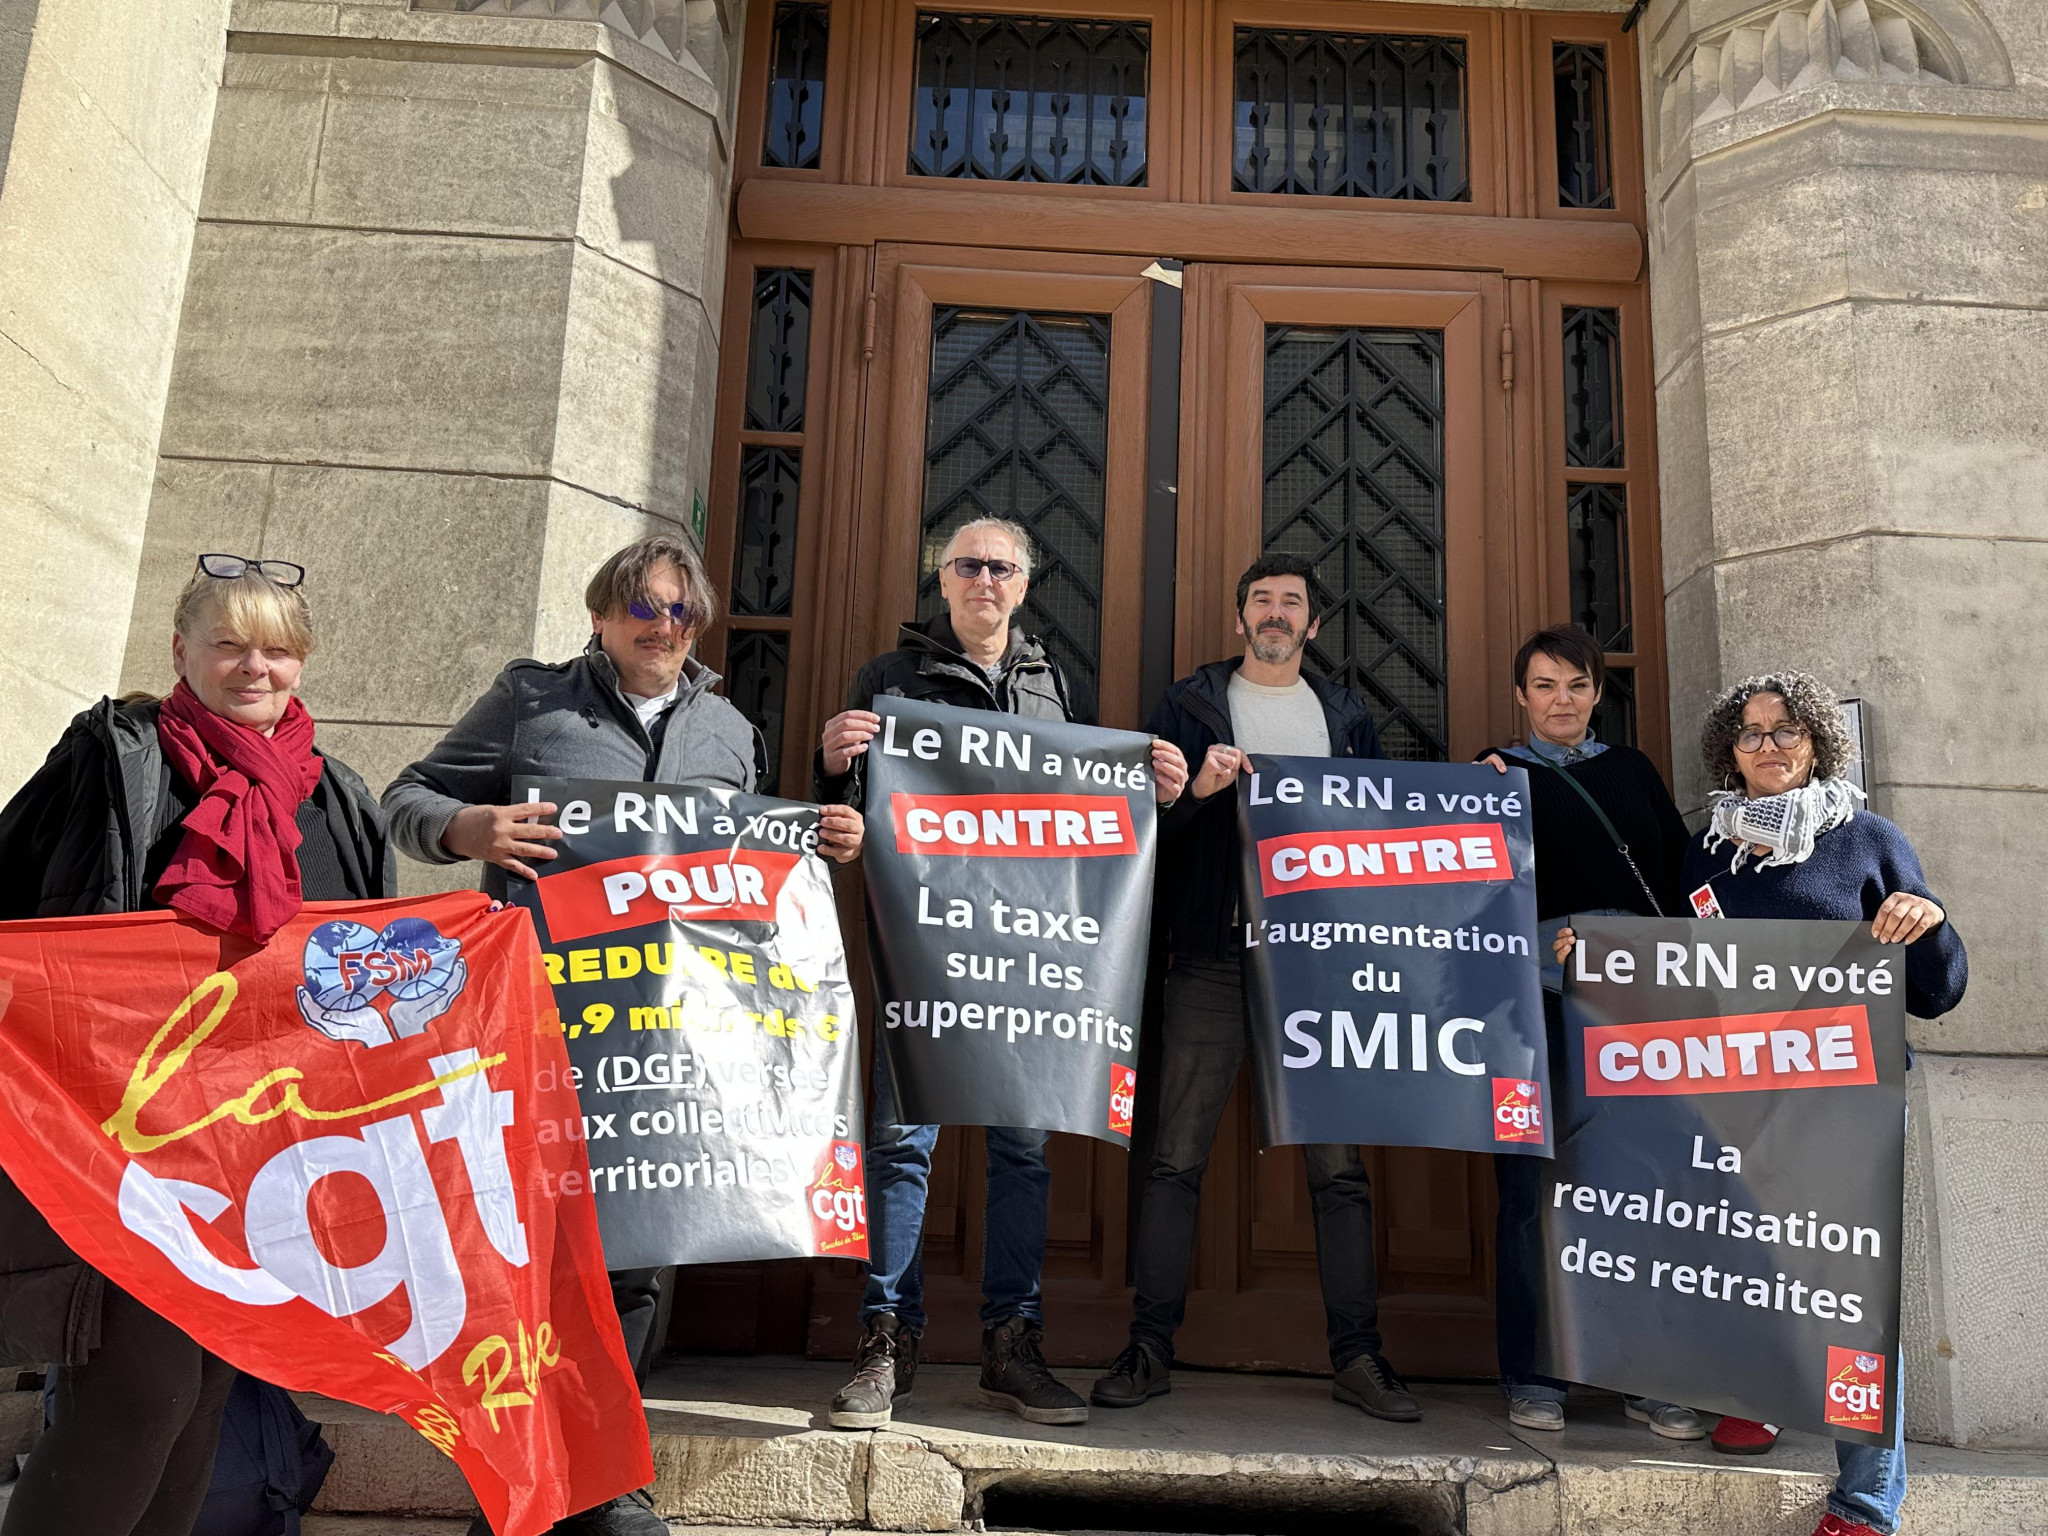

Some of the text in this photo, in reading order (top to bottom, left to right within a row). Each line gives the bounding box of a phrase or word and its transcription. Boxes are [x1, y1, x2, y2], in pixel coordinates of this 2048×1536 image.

[883, 715, 1146, 791] Le RN a voté
[1249, 772, 1522, 817] Le RN a voté
[614, 792, 699, 835] RN
[712, 815, 736, 835] a
[748, 815, 819, 852] voté
[905, 808, 1124, 846] CONTRE
[1271, 836, 1498, 882] CONTRE
[602, 863, 769, 916] POUR
[917, 886, 1100, 945] La taxe
[1245, 919, 1529, 956] L'augmentation
[338, 948, 433, 992] FSM
[946, 951, 1084, 991] sur les
[1351, 963, 1401, 993] du
[1575, 939, 1893, 995] Le RN a voté
[885, 1000, 1134, 1052] superprofits
[1282, 1010, 1487, 1076] SMIC
[102, 971, 506, 1153] la
[534, 1060, 583, 1092] de
[596, 1054, 708, 1093] (DGF)
[1599, 1024, 1858, 1082] CONTRE
[537, 1112, 618, 1144] aux
[1496, 1104, 1540, 1129] cgt
[540, 1152, 790, 1198] territoriales
[813, 1162, 862, 1191] la
[1691, 1135, 1742, 1174] La
[118, 1047, 530, 1372] cgt
[811, 1185, 866, 1231] cgt
[1553, 1182, 1881, 1258] revalorisation
[1560, 1237, 1863, 1324] des retraites
[1828, 1381, 1880, 1413] cgt
[1832, 1365, 1880, 1388] la
